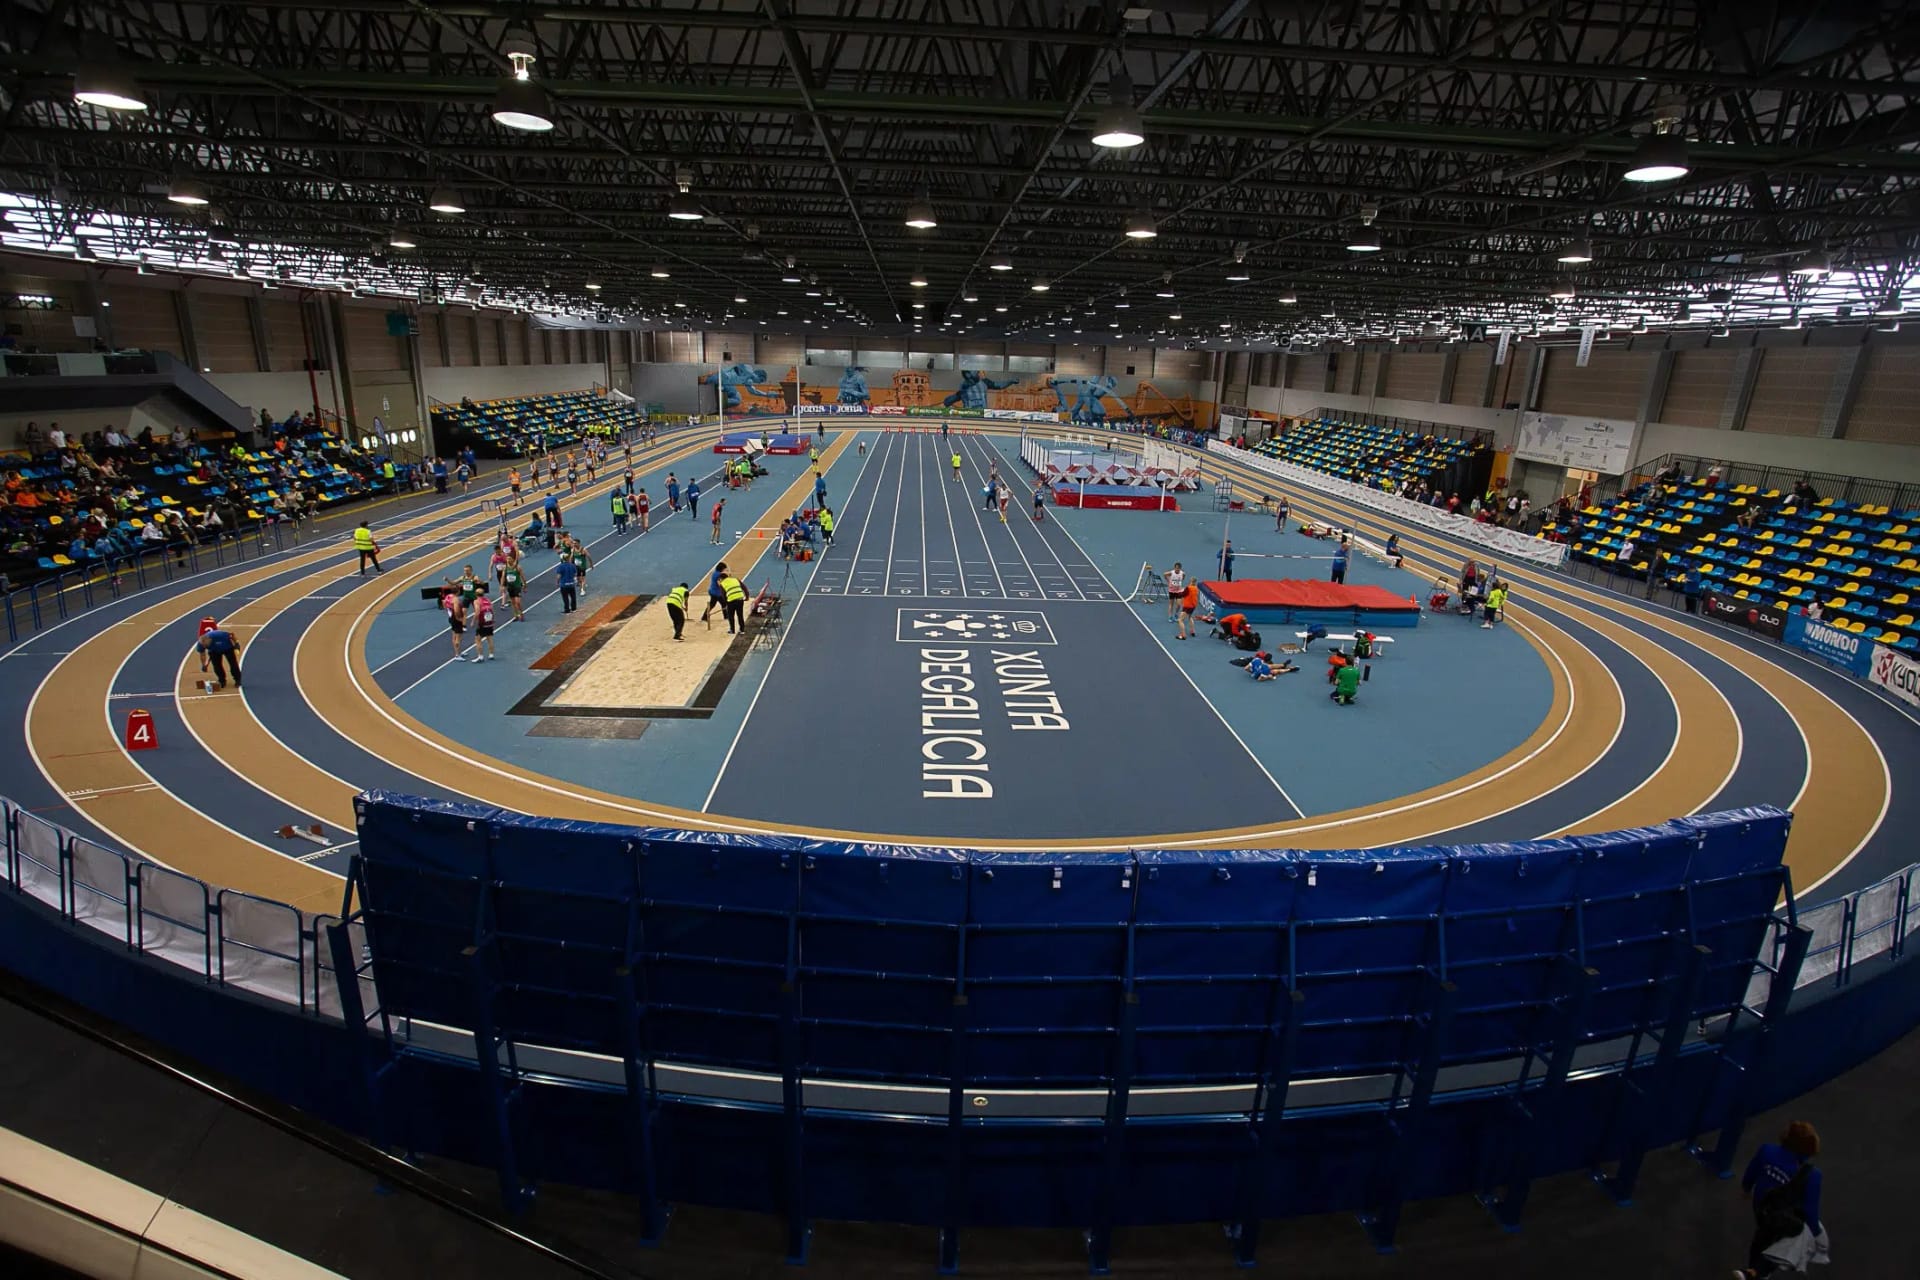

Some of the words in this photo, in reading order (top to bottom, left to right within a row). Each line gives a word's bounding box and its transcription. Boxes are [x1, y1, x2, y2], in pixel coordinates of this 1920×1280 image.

[1470, 326, 1484, 341] A
[1810, 624, 1860, 655] MONDO
[990, 649, 1070, 730] XUNTA
[133, 723, 150, 743] 4
